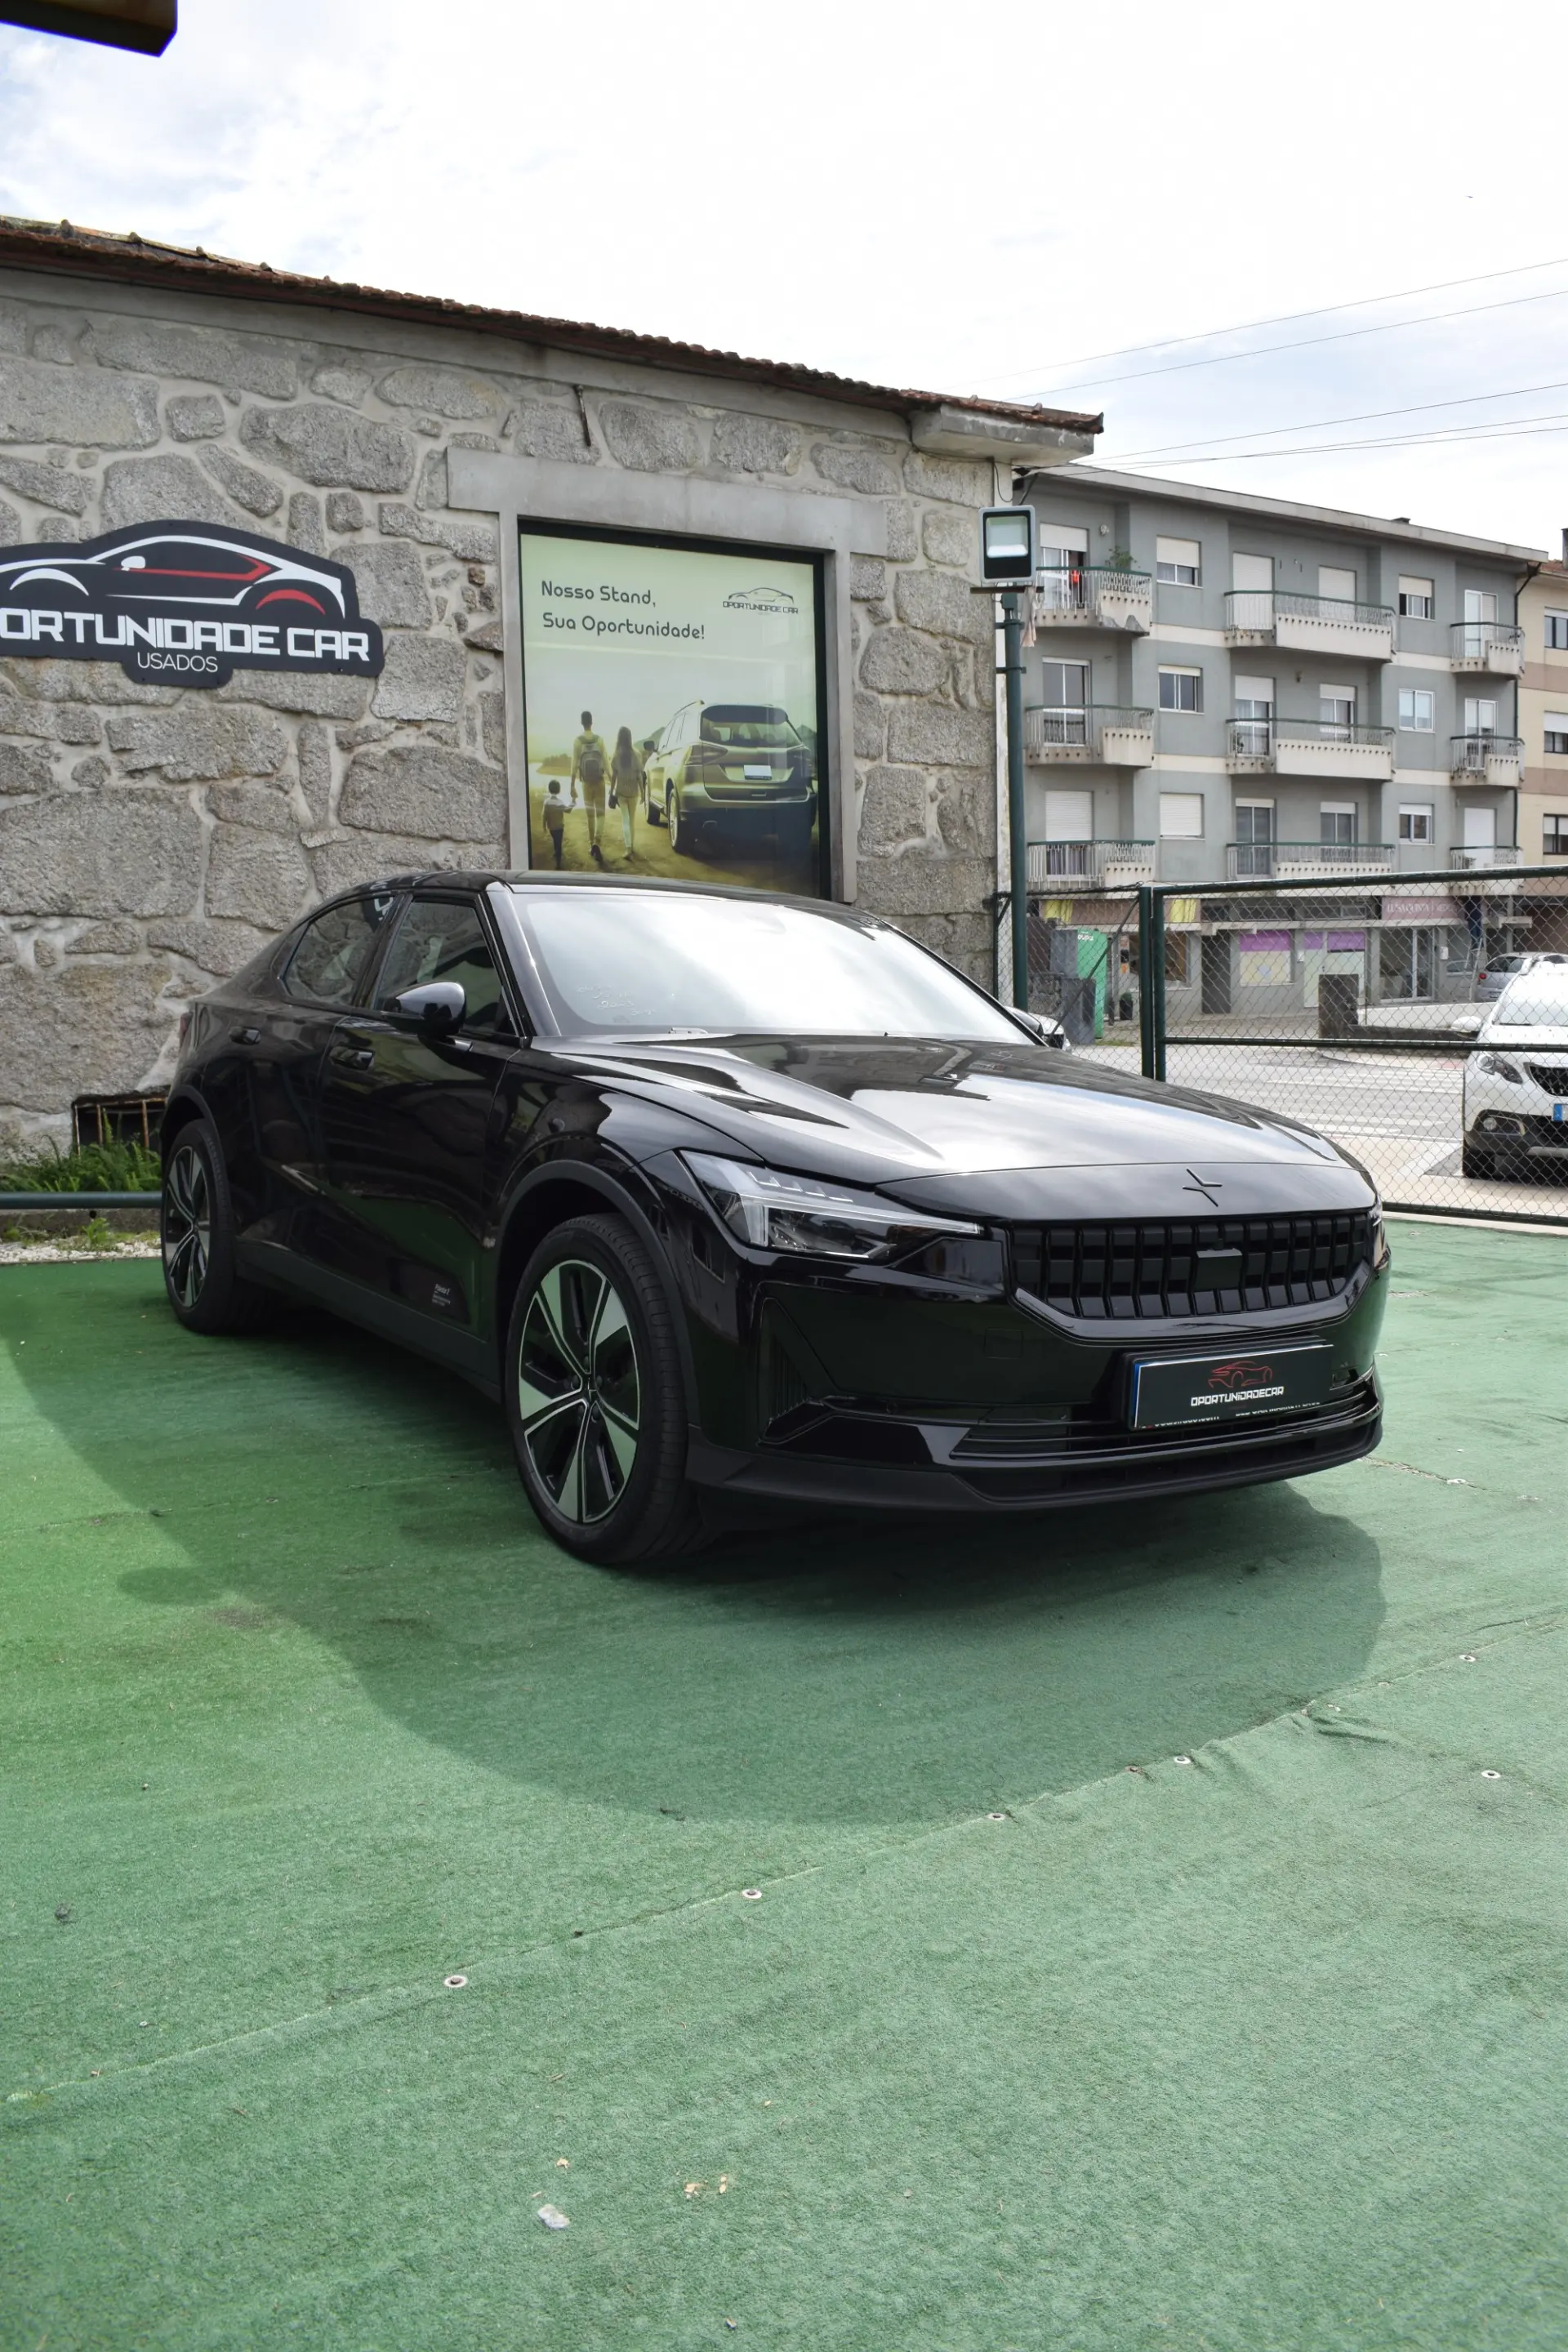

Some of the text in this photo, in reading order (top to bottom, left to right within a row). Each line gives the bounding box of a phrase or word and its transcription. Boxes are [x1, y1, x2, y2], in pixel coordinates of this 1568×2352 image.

[541, 581, 656, 607] Nosso Stand,
[542, 612, 705, 639] Sua Oportunidade!
[287, 627, 370, 662] CAR
[137, 653, 218, 673] USADOS
